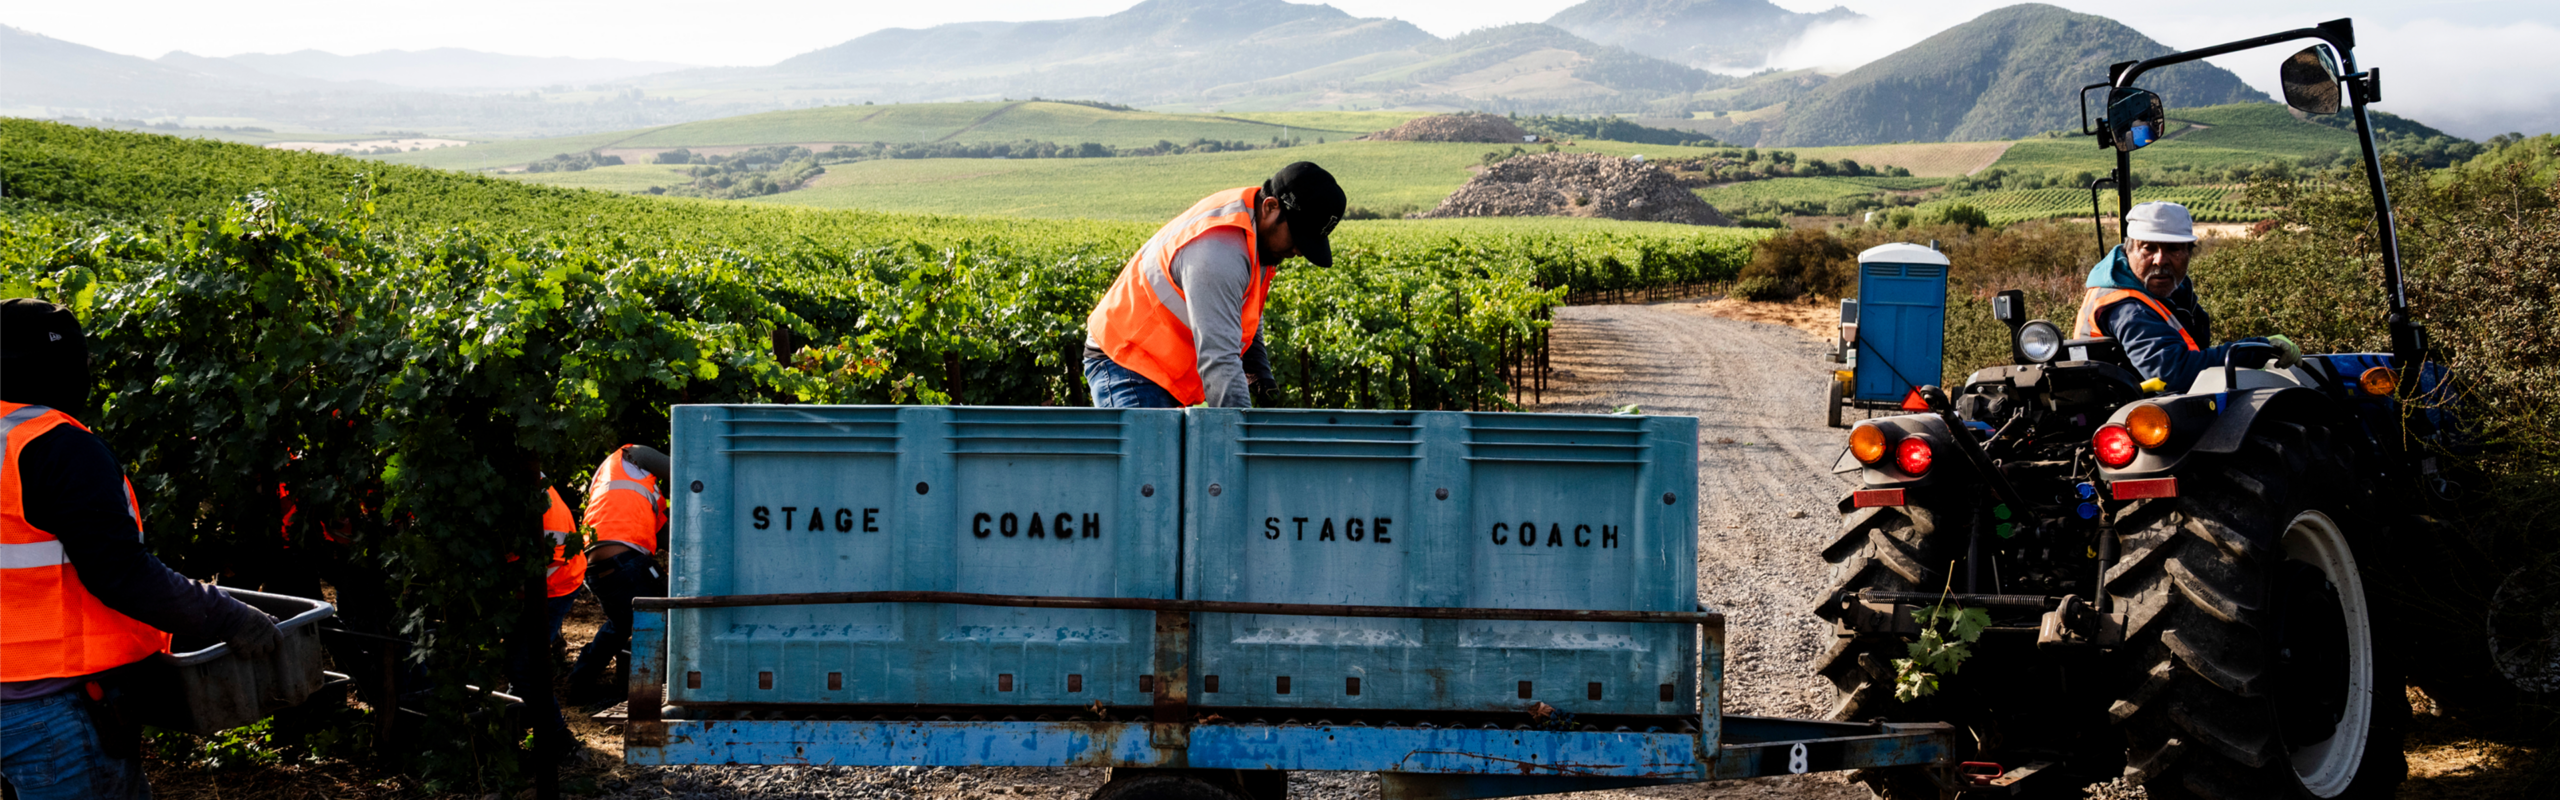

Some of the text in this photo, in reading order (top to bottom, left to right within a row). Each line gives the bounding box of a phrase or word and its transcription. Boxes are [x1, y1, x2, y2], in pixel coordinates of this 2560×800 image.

[752, 506, 1100, 540] STAGE COACH
[1265, 517, 1618, 549] STAGE COACH
[1789, 743, 1808, 774] 8
